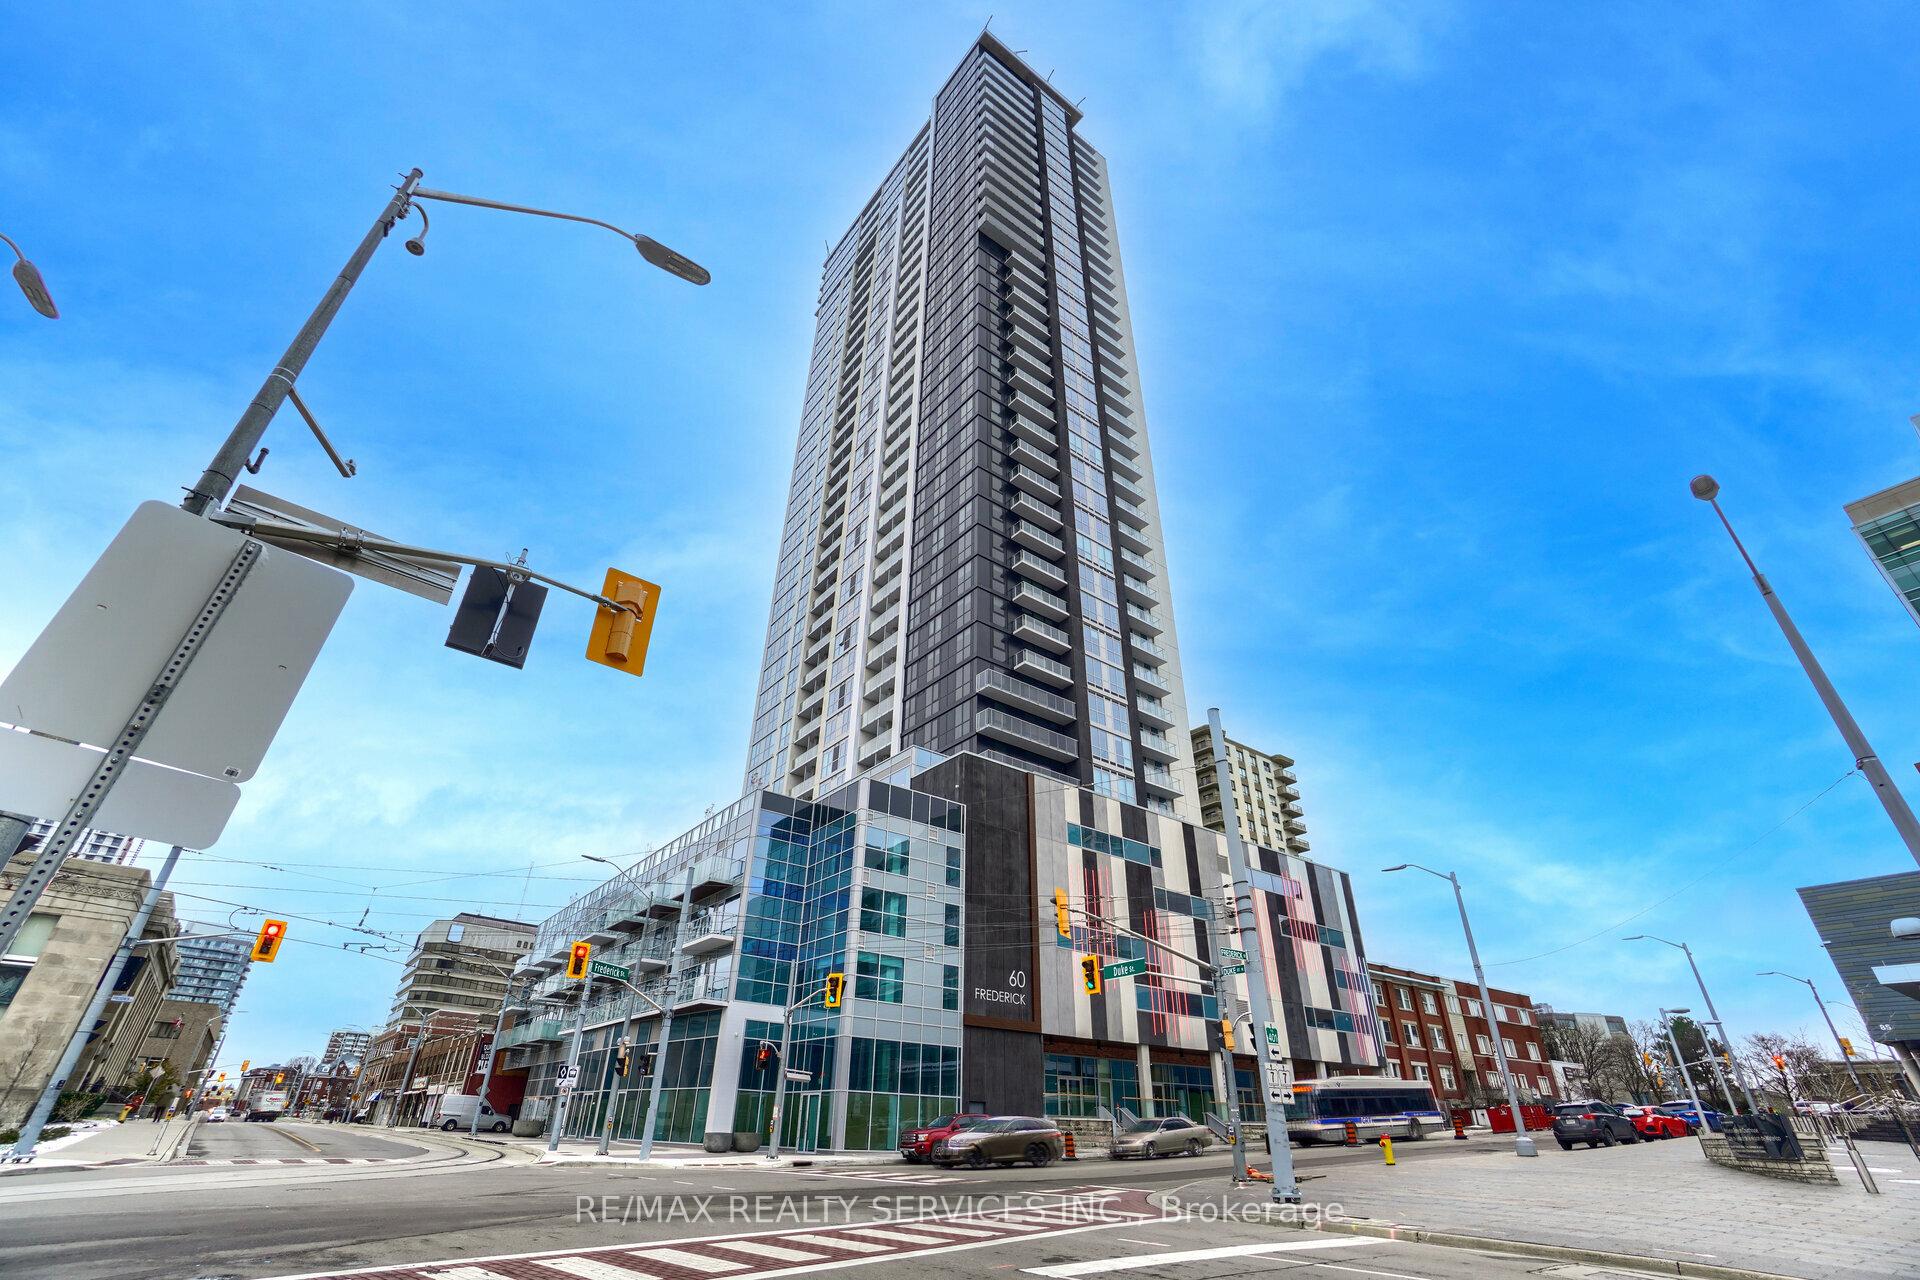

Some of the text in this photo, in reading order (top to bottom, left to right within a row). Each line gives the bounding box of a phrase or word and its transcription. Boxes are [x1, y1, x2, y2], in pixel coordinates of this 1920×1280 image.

[594, 963, 620, 977] Frederick
[1113, 965, 1128, 977] Duke
[1222, 968, 1236, 976] DUKE
[1009, 970, 1026, 988] 60
[975, 987, 1026, 1006] FREDERICK
[1270, 1071, 1275, 1083] 7
[1282, 1072, 1287, 1084] 7
